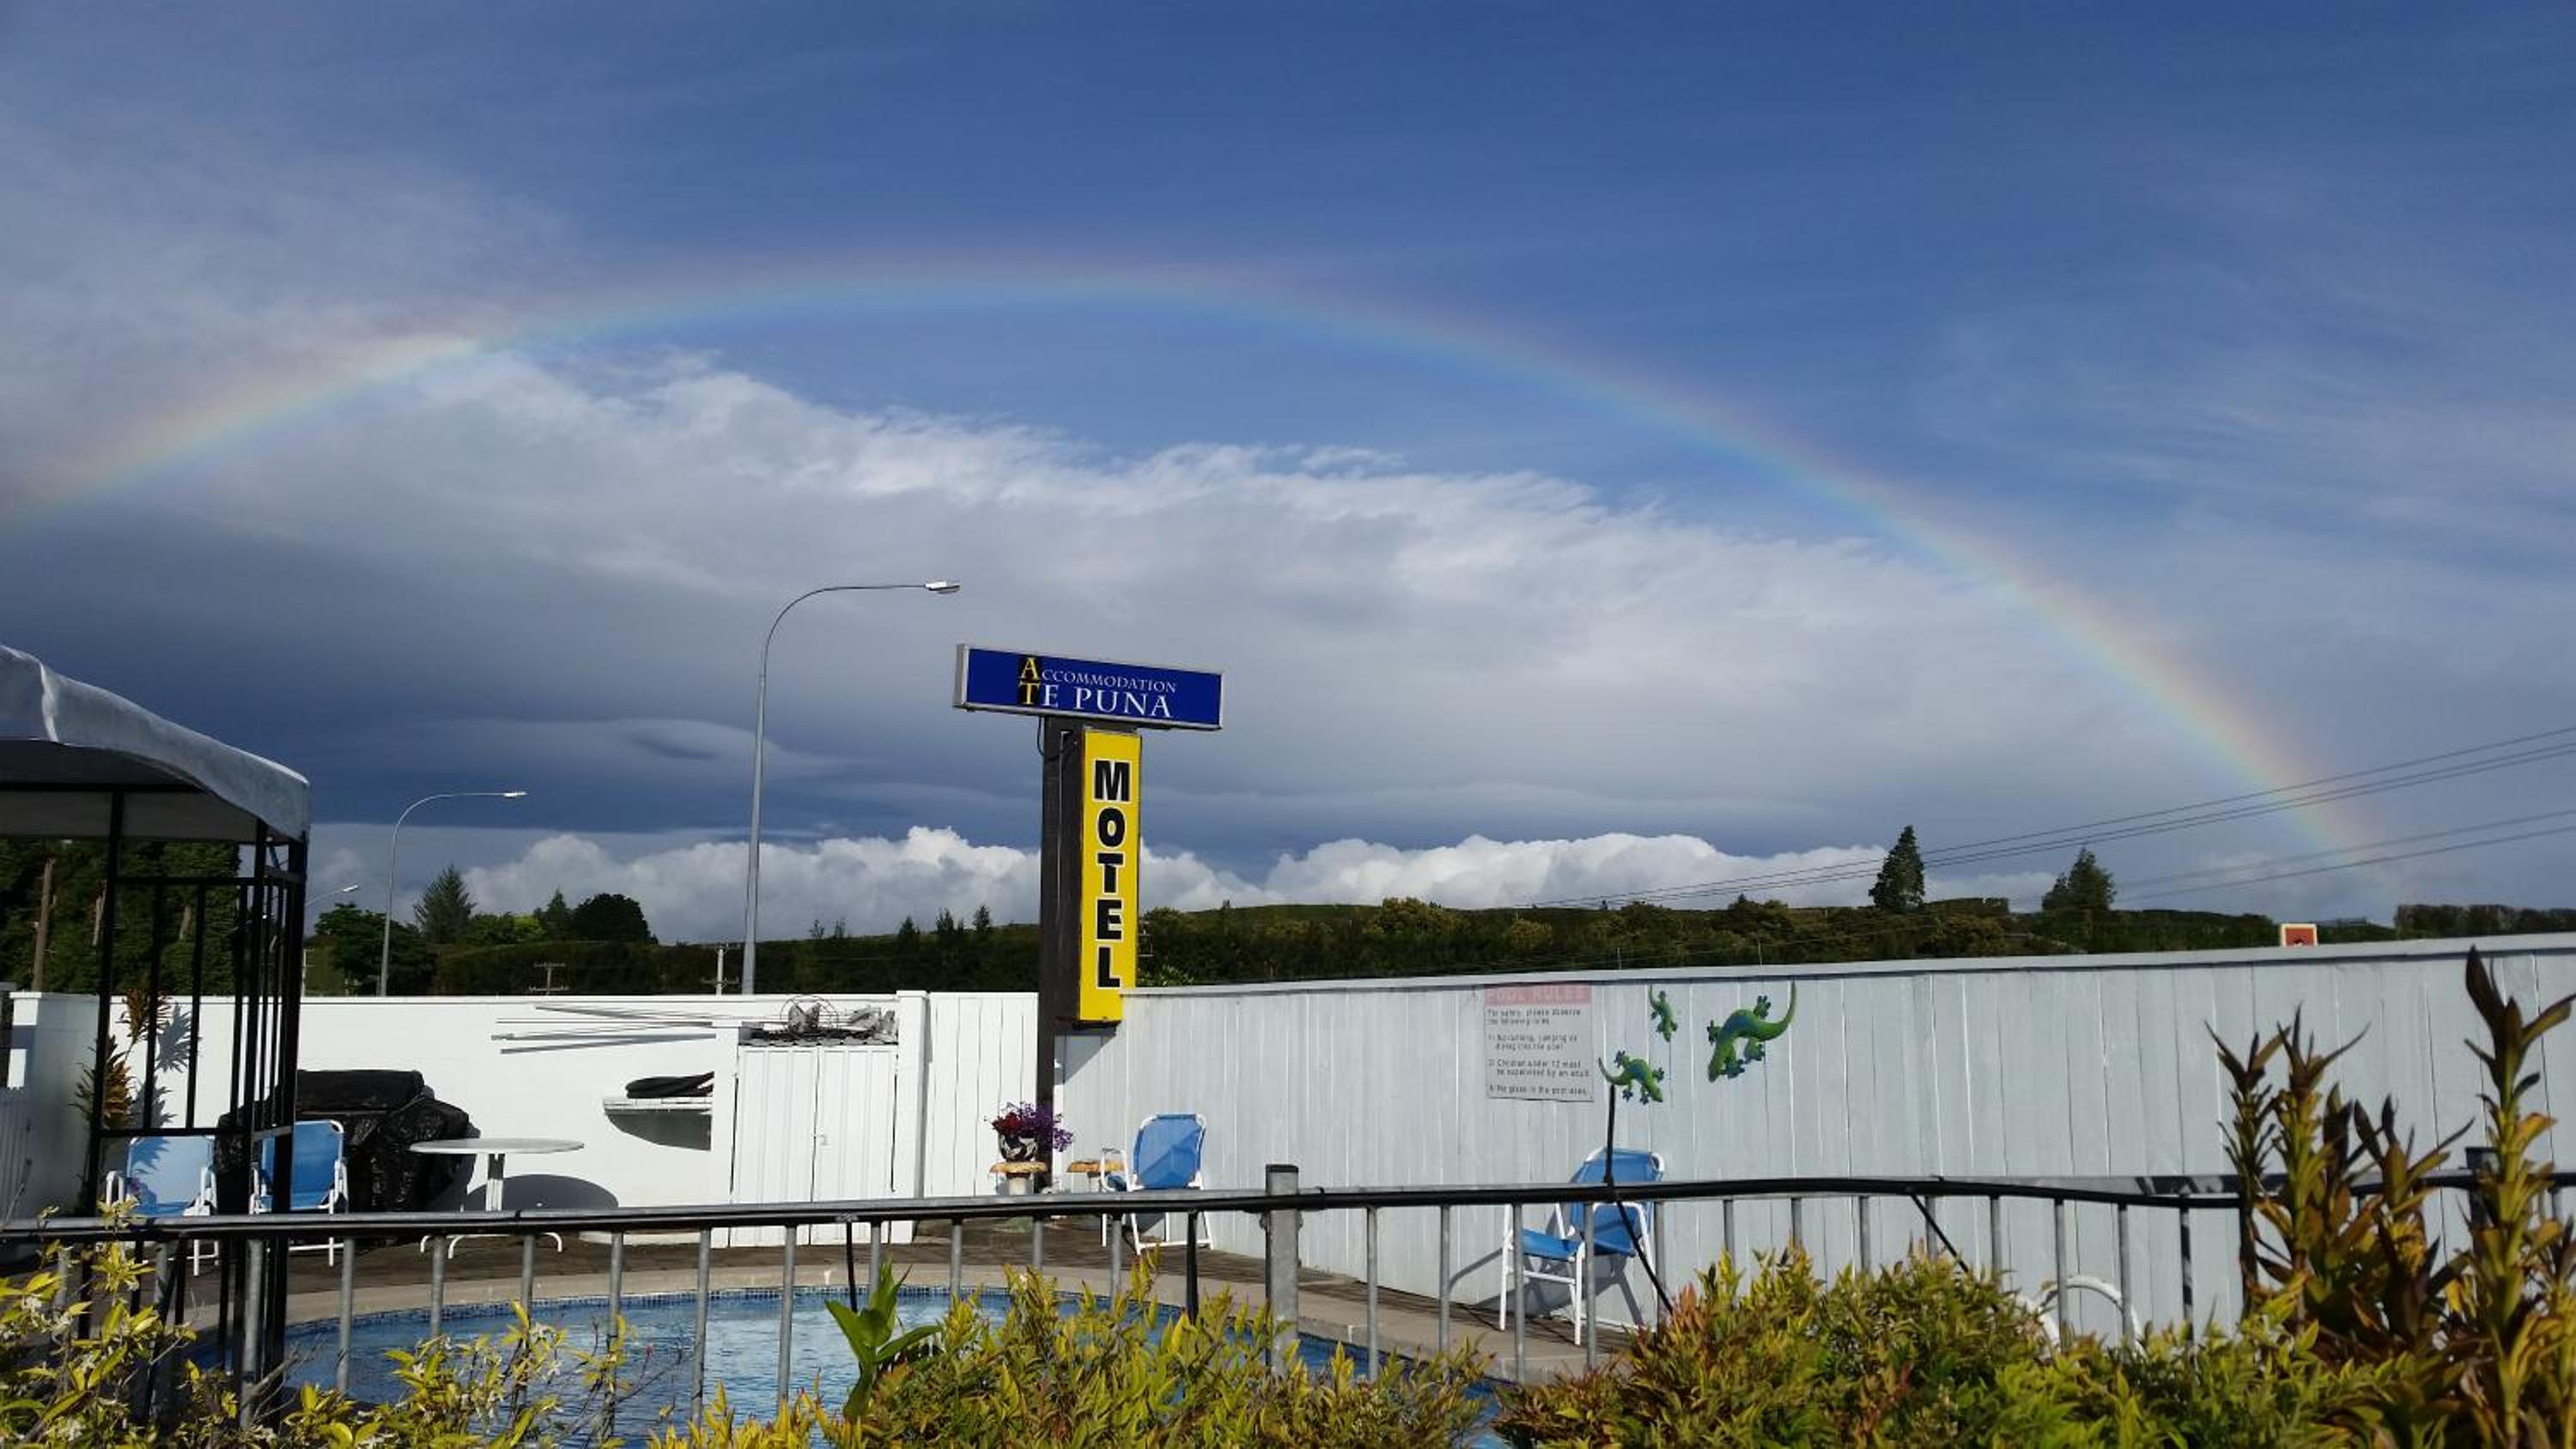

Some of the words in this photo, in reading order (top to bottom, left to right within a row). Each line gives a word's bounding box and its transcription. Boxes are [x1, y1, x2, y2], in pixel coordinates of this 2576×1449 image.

[1019, 658, 1177, 694] ACCOMMODATION
[1019, 682, 1060, 707] TE
[1072, 688, 1175, 718] PUNA
[1093, 759, 1131, 989] MOTEL
